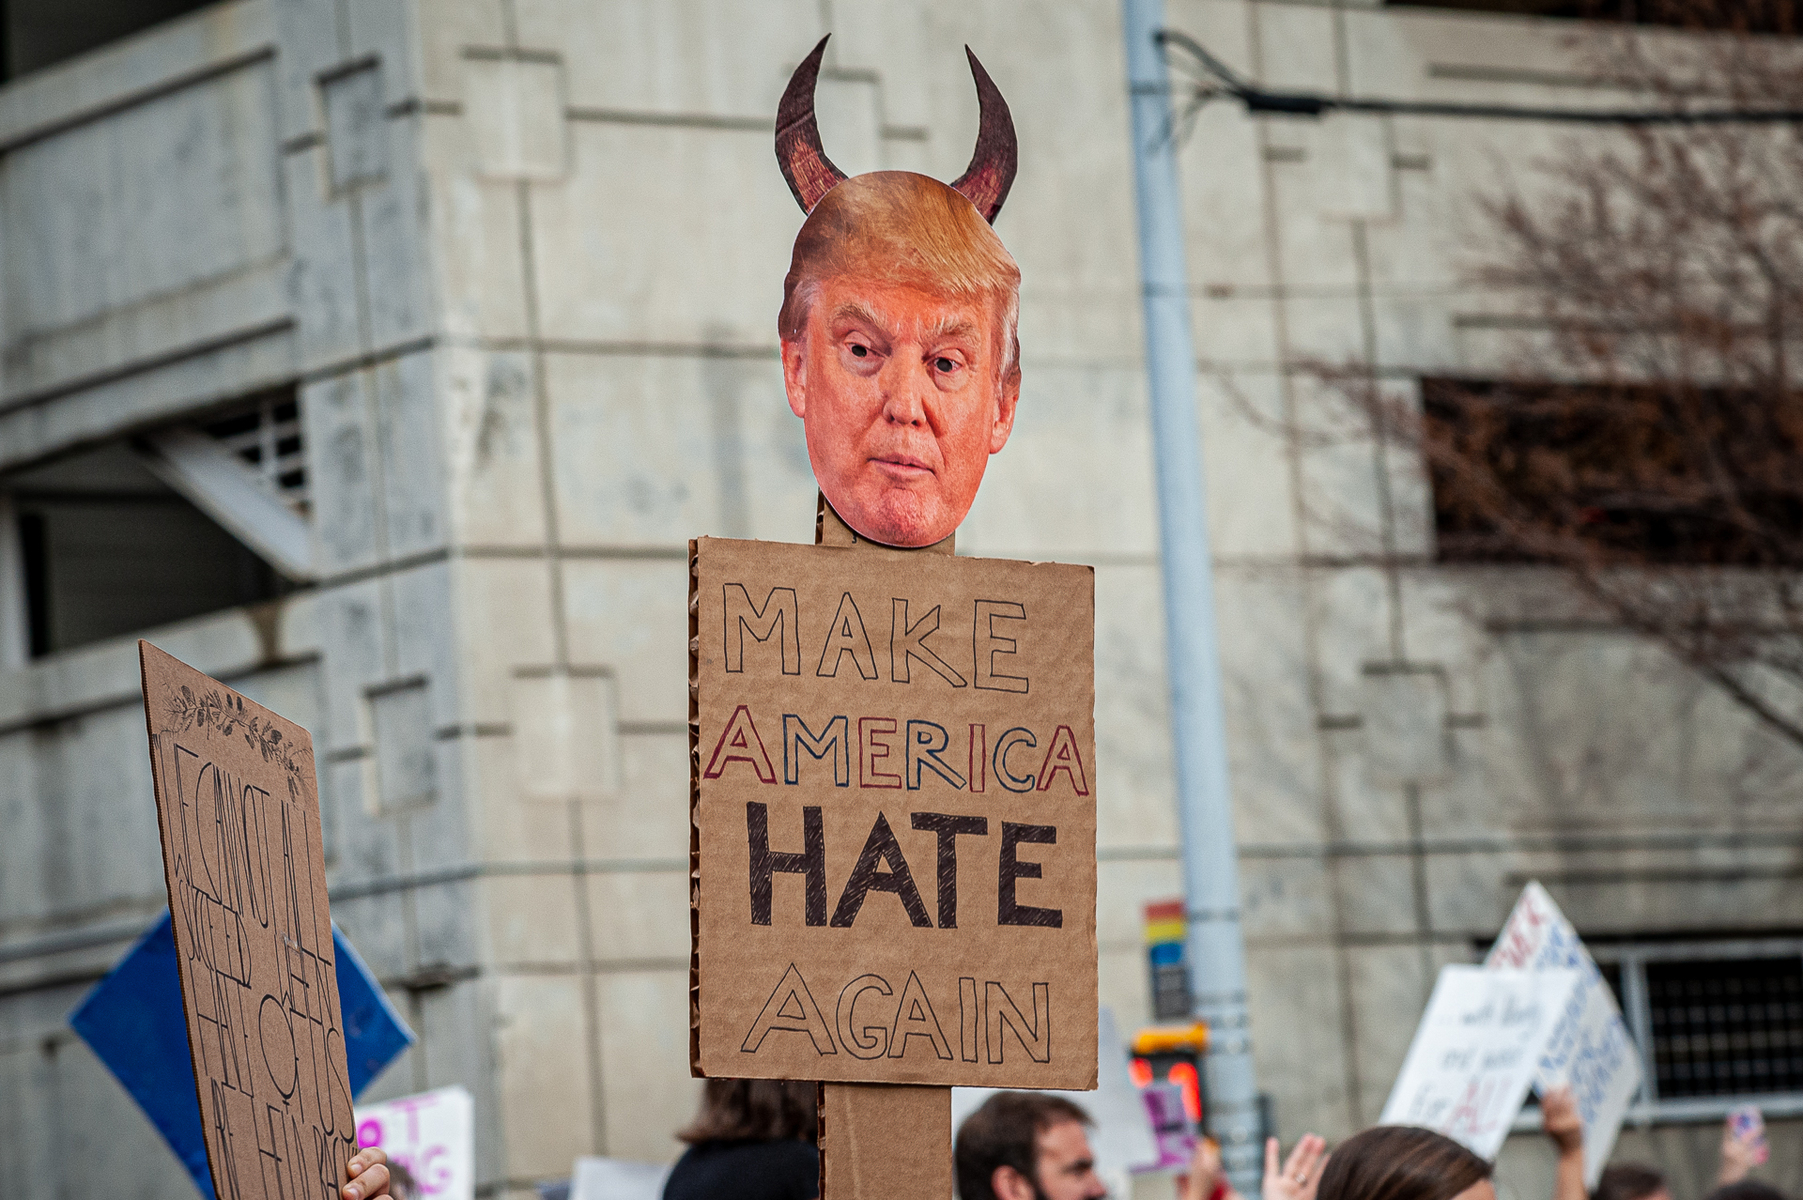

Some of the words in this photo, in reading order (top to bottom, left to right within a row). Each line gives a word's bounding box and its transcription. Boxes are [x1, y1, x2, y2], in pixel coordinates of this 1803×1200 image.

[723, 583, 1030, 694] MAKE
[703, 704, 1090, 797] AMERICA
[196, 761, 277, 935] CANNOT
[280, 799, 333, 966] ALL
[746, 801, 1063, 929] HATE
[179, 879, 252, 990] SUCCEED
[273, 933, 334, 1029] WHEN
[740, 962, 1051, 1064] AGAIN
[188, 957, 255, 1099] HALF
[308, 1015, 356, 1144] US
